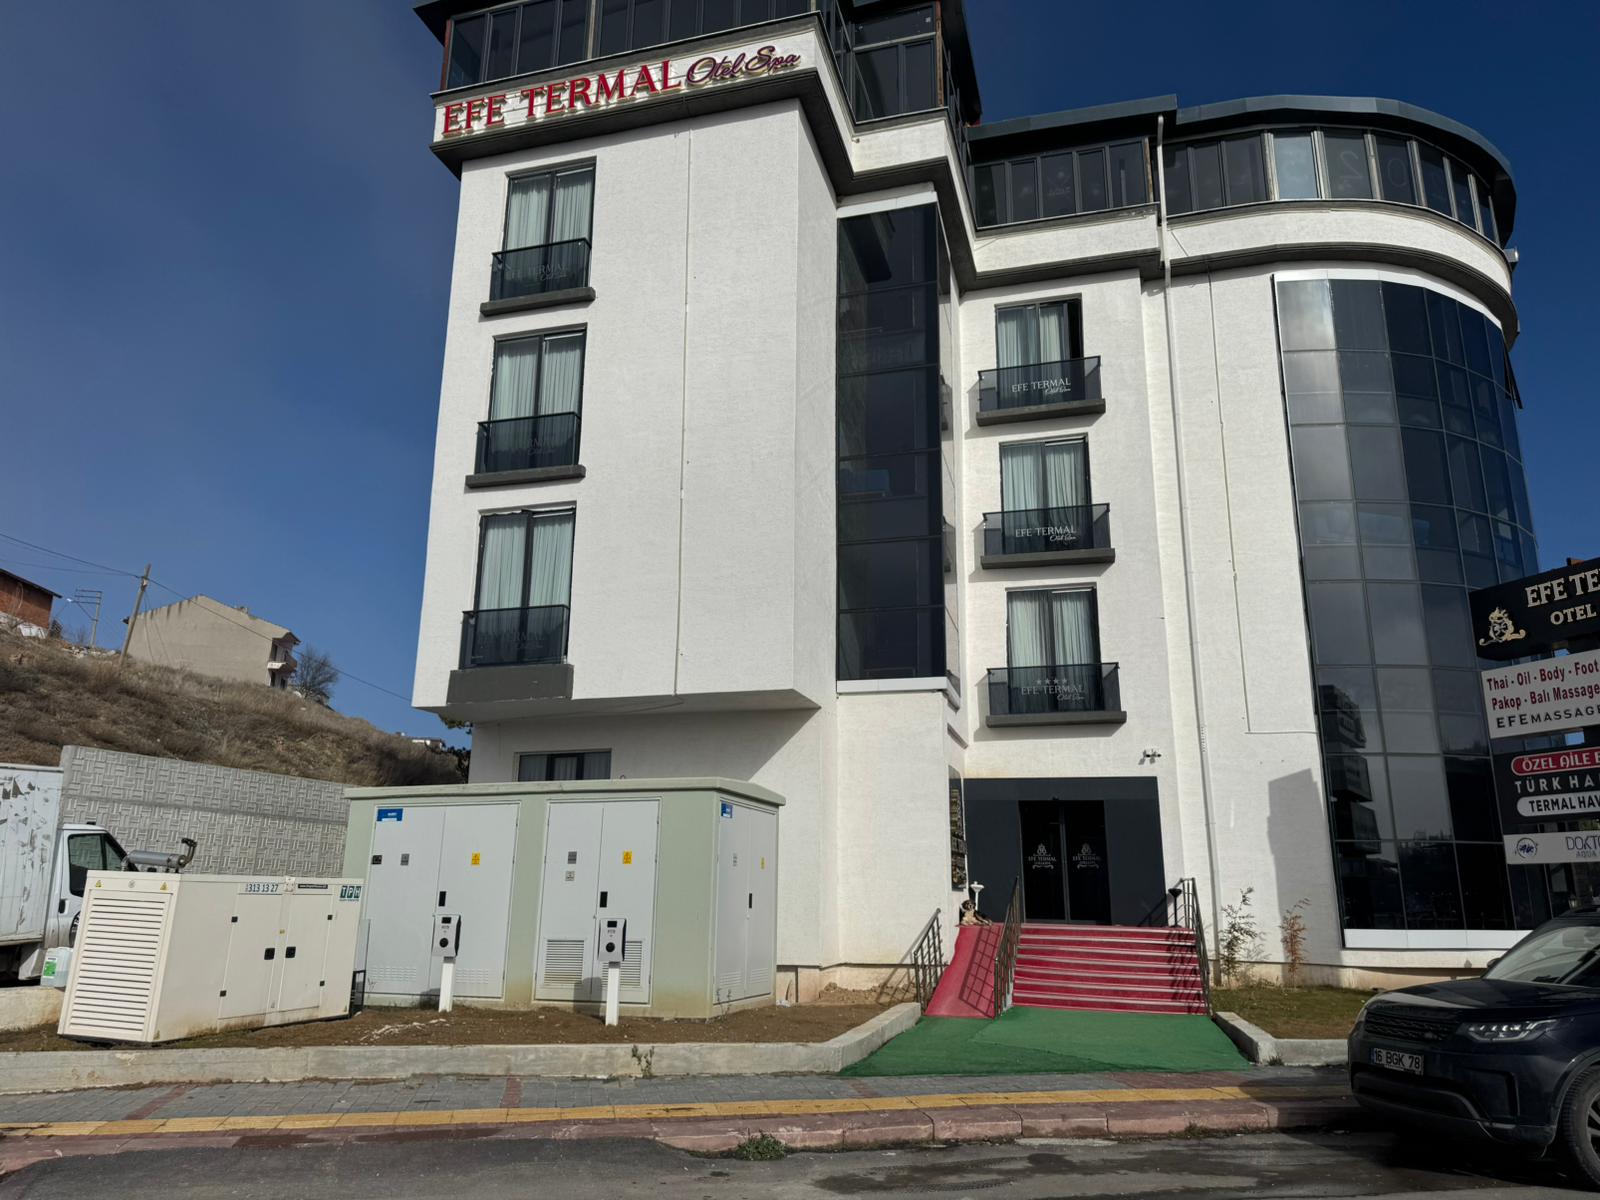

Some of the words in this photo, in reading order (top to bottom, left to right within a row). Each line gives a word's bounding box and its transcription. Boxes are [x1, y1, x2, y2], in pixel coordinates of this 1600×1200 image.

[443, 94, 507, 136] EFE
[521, 60, 682, 118] TERMAL
[687, 52, 746, 83] Otel
[745, 45, 801, 72] Spa
[1011, 382, 1029, 393] EFE
[1031, 377, 1071, 390] TERMAL
[1015, 527, 1033, 537] EFE
[1035, 524, 1077, 536] TERMAL
[1525, 577, 1568, 608] EFE
[1569, 568, 1600, 596] TE
[1550, 603, 1597, 625] OTEL
[1487, 676, 1509, 691] Thai
[1516, 671, 1531, 686] Oil
[1539, 666, 1565, 682] Body
[1574, 659, 1600, 676] Foot
[1491, 696, 1522, 712] Pakop
[1552, 682, 1600, 701] Massage
[1522, 755, 1556, 772] ÖZEL
[1514, 776, 1562, 794] TÜRK
[1569, 773, 1600, 789] HA
[1529, 798, 1576, 813] TERMAL
[340, 885, 361, 898] TPH
[1408, 1055, 1420, 1069] 78
